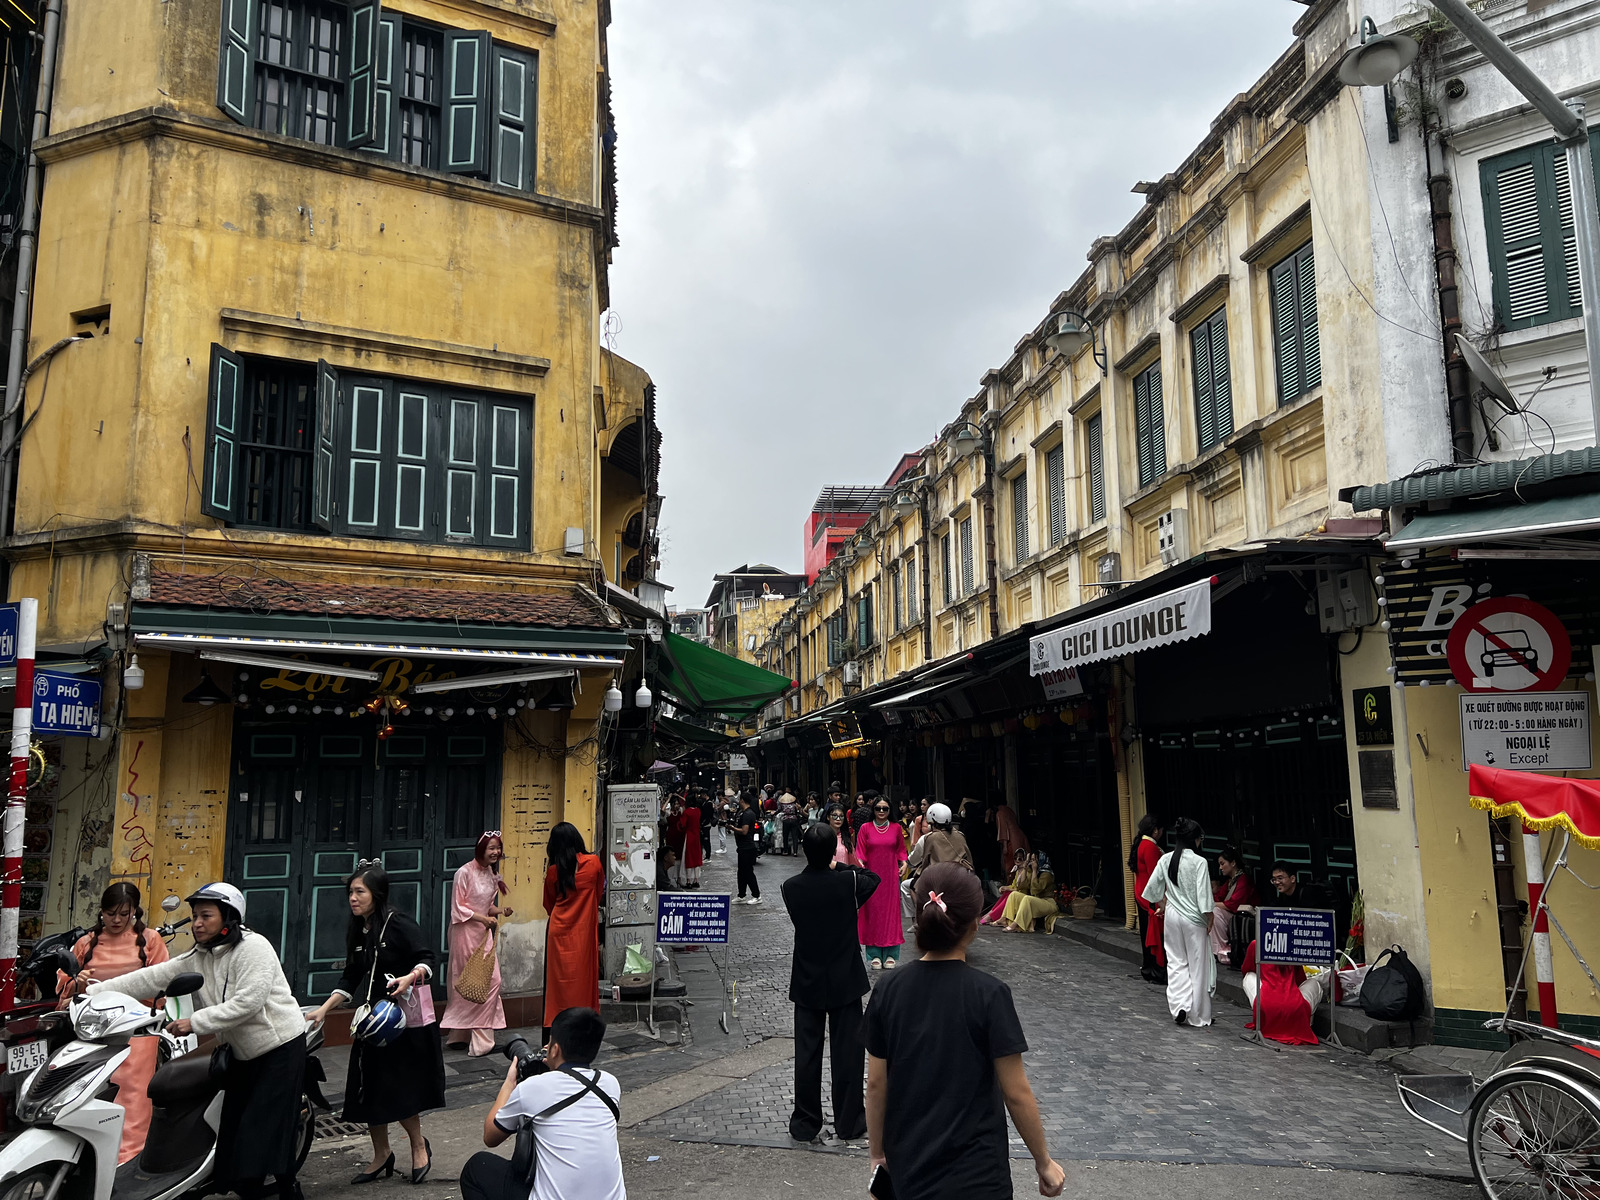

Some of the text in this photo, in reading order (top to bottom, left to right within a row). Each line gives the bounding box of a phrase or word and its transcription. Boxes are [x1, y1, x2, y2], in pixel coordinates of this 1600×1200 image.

[1061, 601, 1187, 661] CICI LOUNGE
[57, 683, 80, 698] PHỐ
[1466, 699, 1585, 713] XE QUÉT ĐƯỜNG ĐƯỢC HOẠT ĐỘNG
[40, 701, 93, 729] TẠ HIỆN
[1537, 717, 1556, 728] HÀNG
[1559, 716, 1578, 728] NGÀY
[1506, 734, 1550, 751] NGOẠI LỆ
[1510, 753, 1549, 766] Except
[660, 909, 683, 934] CẤM
[1264, 925, 1288, 953] CẤM
[13, 1042, 40, 1059] 99-E1
[10, 1054, 45, 1072] 474.56
[99, 1115, 120, 1124] HONDA
